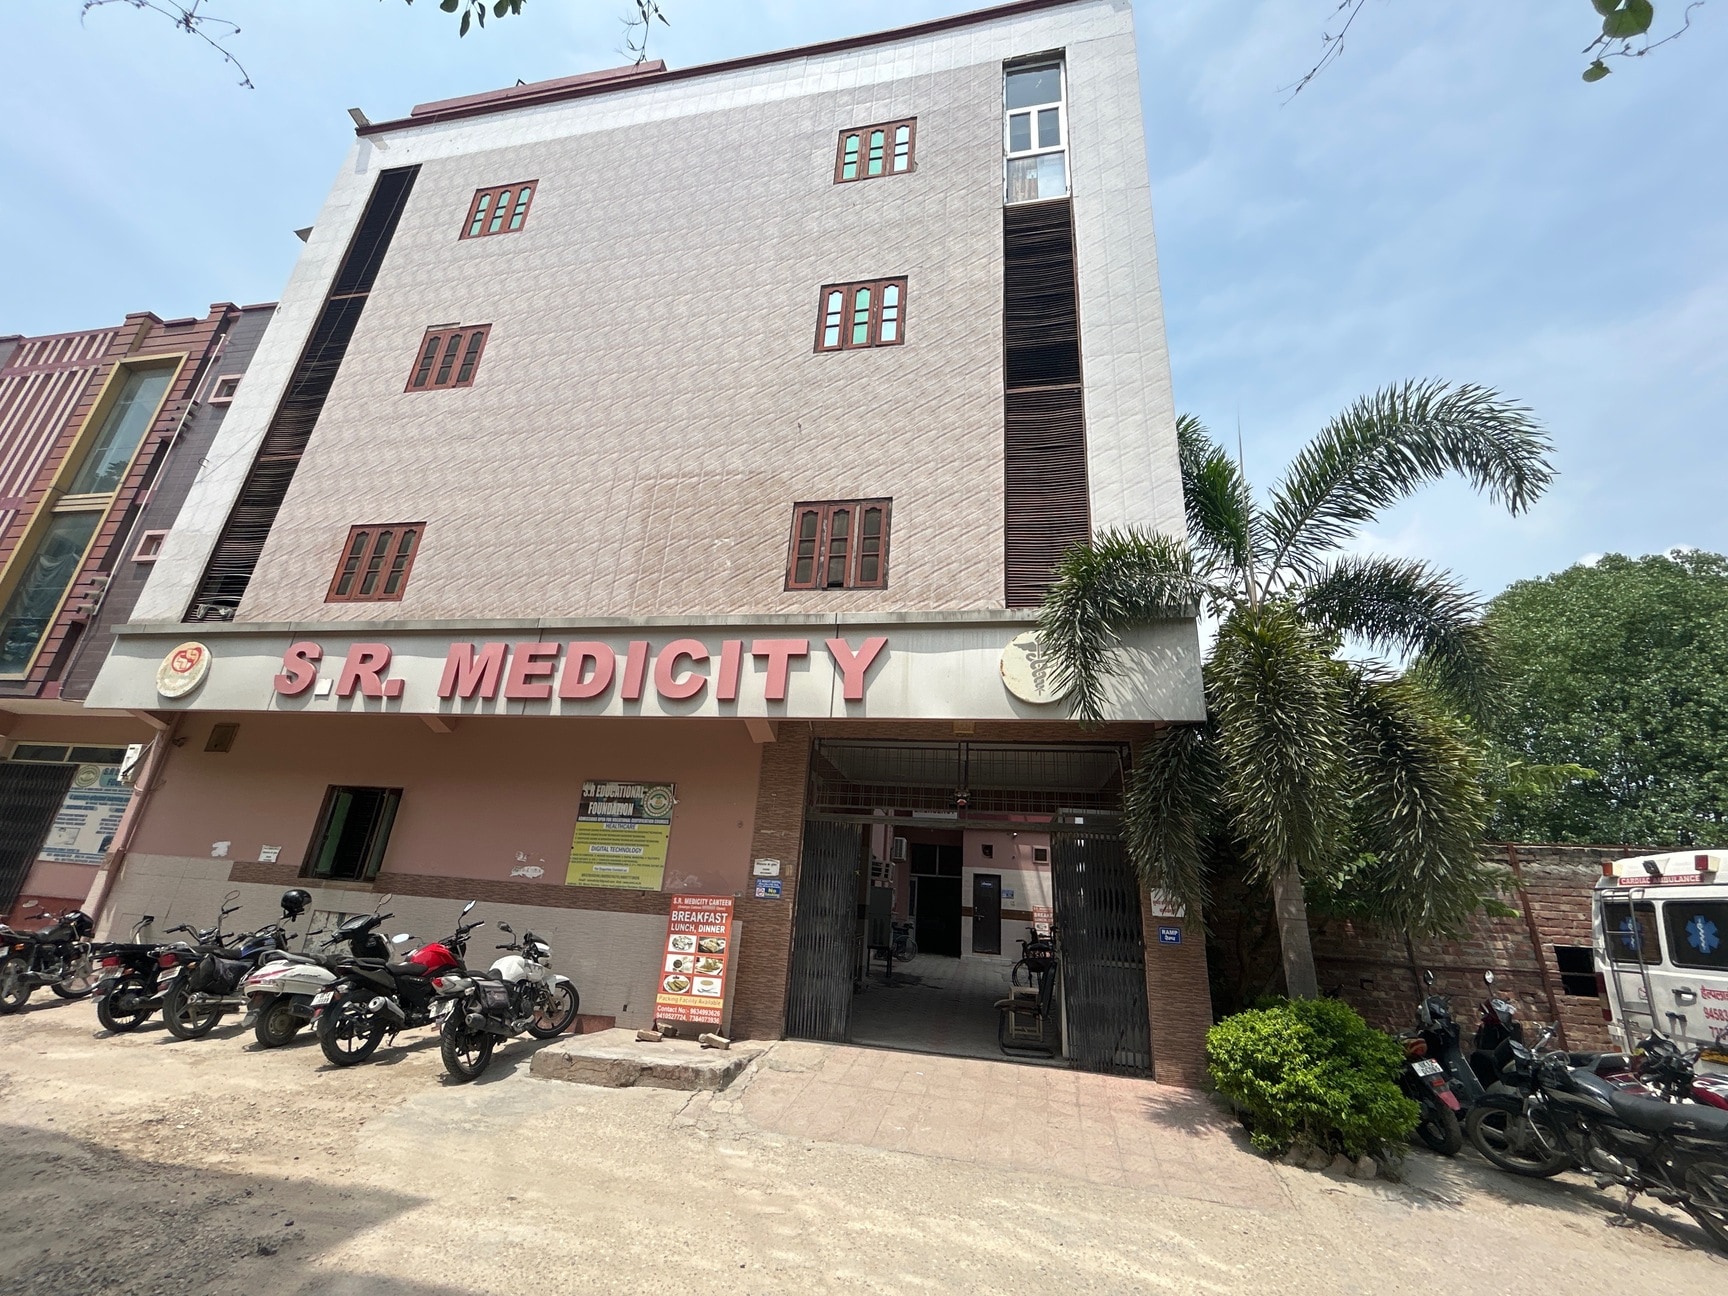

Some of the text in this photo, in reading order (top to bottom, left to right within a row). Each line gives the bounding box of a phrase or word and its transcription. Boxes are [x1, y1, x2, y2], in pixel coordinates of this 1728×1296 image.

[274, 637, 889, 699] S.R. MEDICITY
[596, 784, 644, 798] EDUCATIONAL
[588, 802, 634, 816] FOUNDATION
[672, 911, 728, 923] BREAKFAST
[671, 923, 725, 933] LUNCH, DINNER
